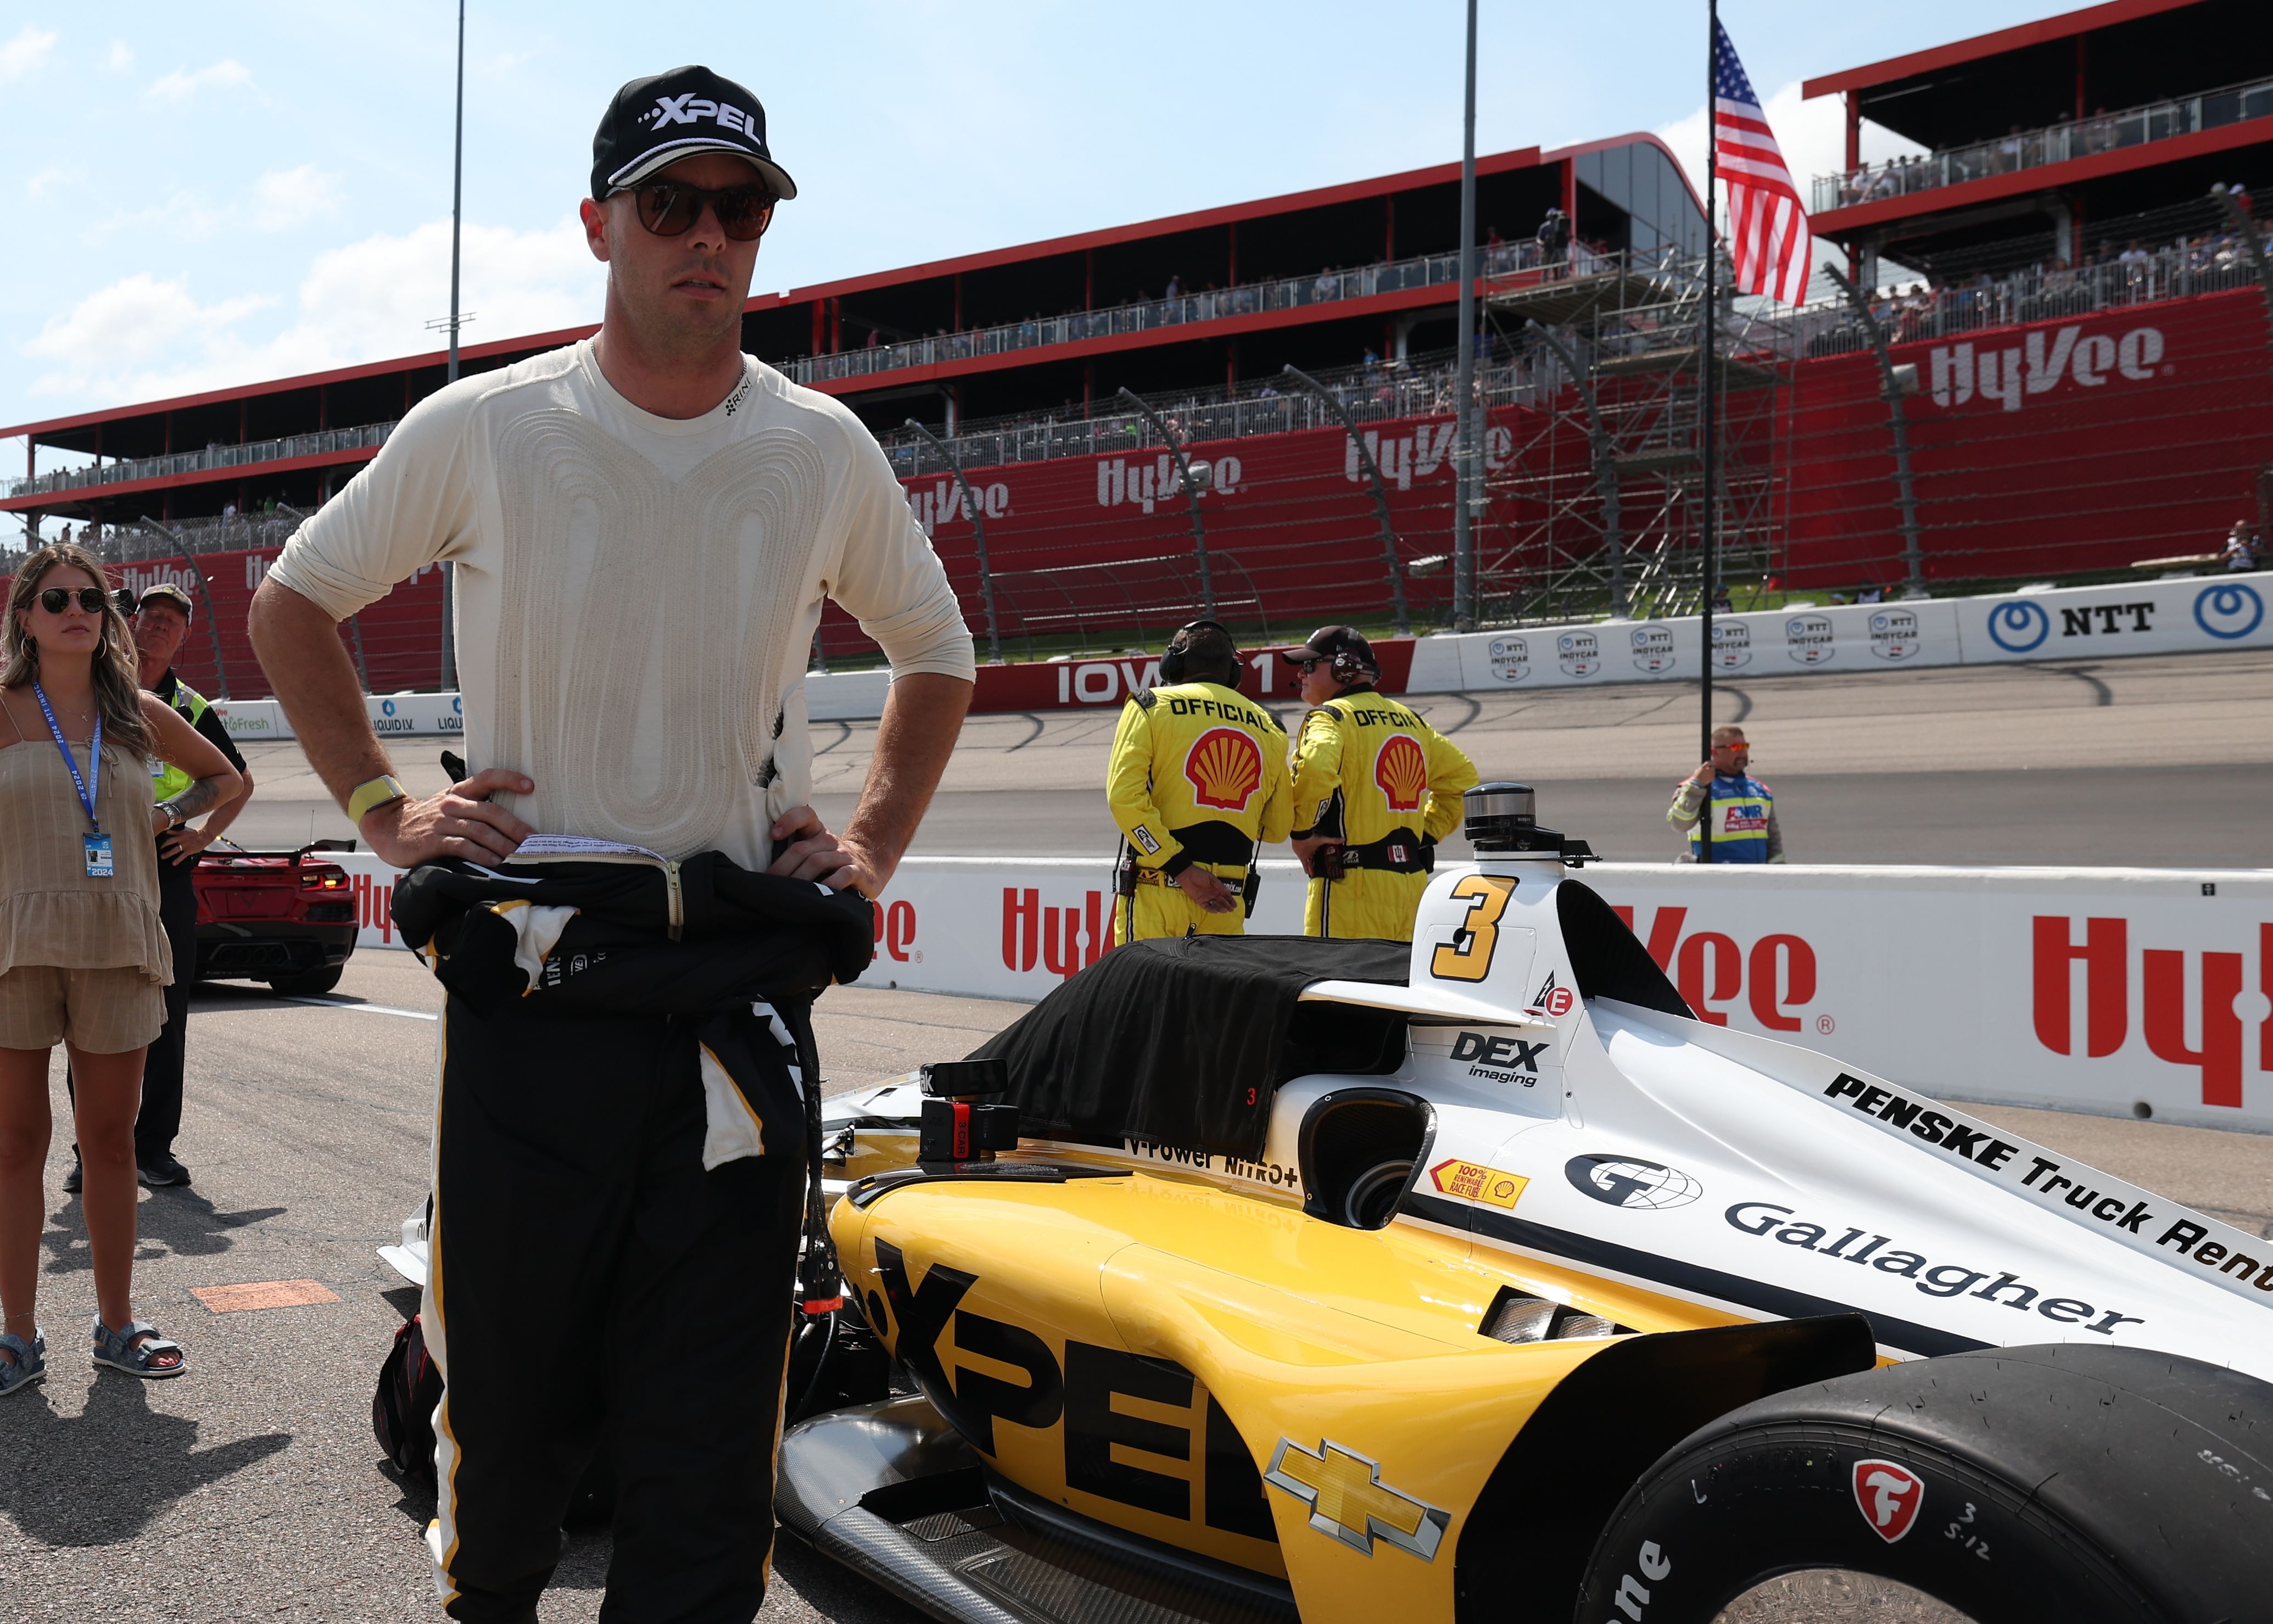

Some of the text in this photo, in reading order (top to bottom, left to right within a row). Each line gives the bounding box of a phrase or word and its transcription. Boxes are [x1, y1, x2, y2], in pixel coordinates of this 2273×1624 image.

[651, 92, 761, 146] XPEL
[1930, 326, 2164, 412] HyVee
[732, 377, 751, 405] RINI
[903, 479, 1008, 537] yVee
[2062, 602, 2154, 637] NTT
[1712, 641, 1750, 649] NDYCAR
[1788, 635, 1833, 645] INDYCAR
[1871, 631, 1918, 640] INDYCAR
[1491, 656, 1528, 664] INDYCAR
[1560, 651, 1598, 660] INDYCAR
[1633, 646, 1673, 655] INDYCAR
[33, 683, 64, 744] 2024 NTT INDYC
[373, 719, 401, 731] IQUID
[438, 717, 463, 730] LIQU
[1170, 699, 1269, 733] OFFICIAL
[71, 770, 84, 790] 2024
[92, 868, 114, 877] 2024
[1430, 874, 1520, 983] 3
[1550, 990, 1569, 1014] E
[1450, 1031, 1551, 1073] DEX
[1468, 1064, 1538, 1088] imaging
[958, 1131, 967, 1154] CAR
[1454, 1174, 1485, 1188] RENEWABLE
[1458, 1165, 1487, 1180] 100%
[1823, 1072, 2273, 1292] PENSKE Truck Rent
[1449, 1181, 1481, 1198] RACE FUEL
[1724, 1202, 2146, 1336] Gallagher
[874, 1236, 1280, 1543] XPEL
